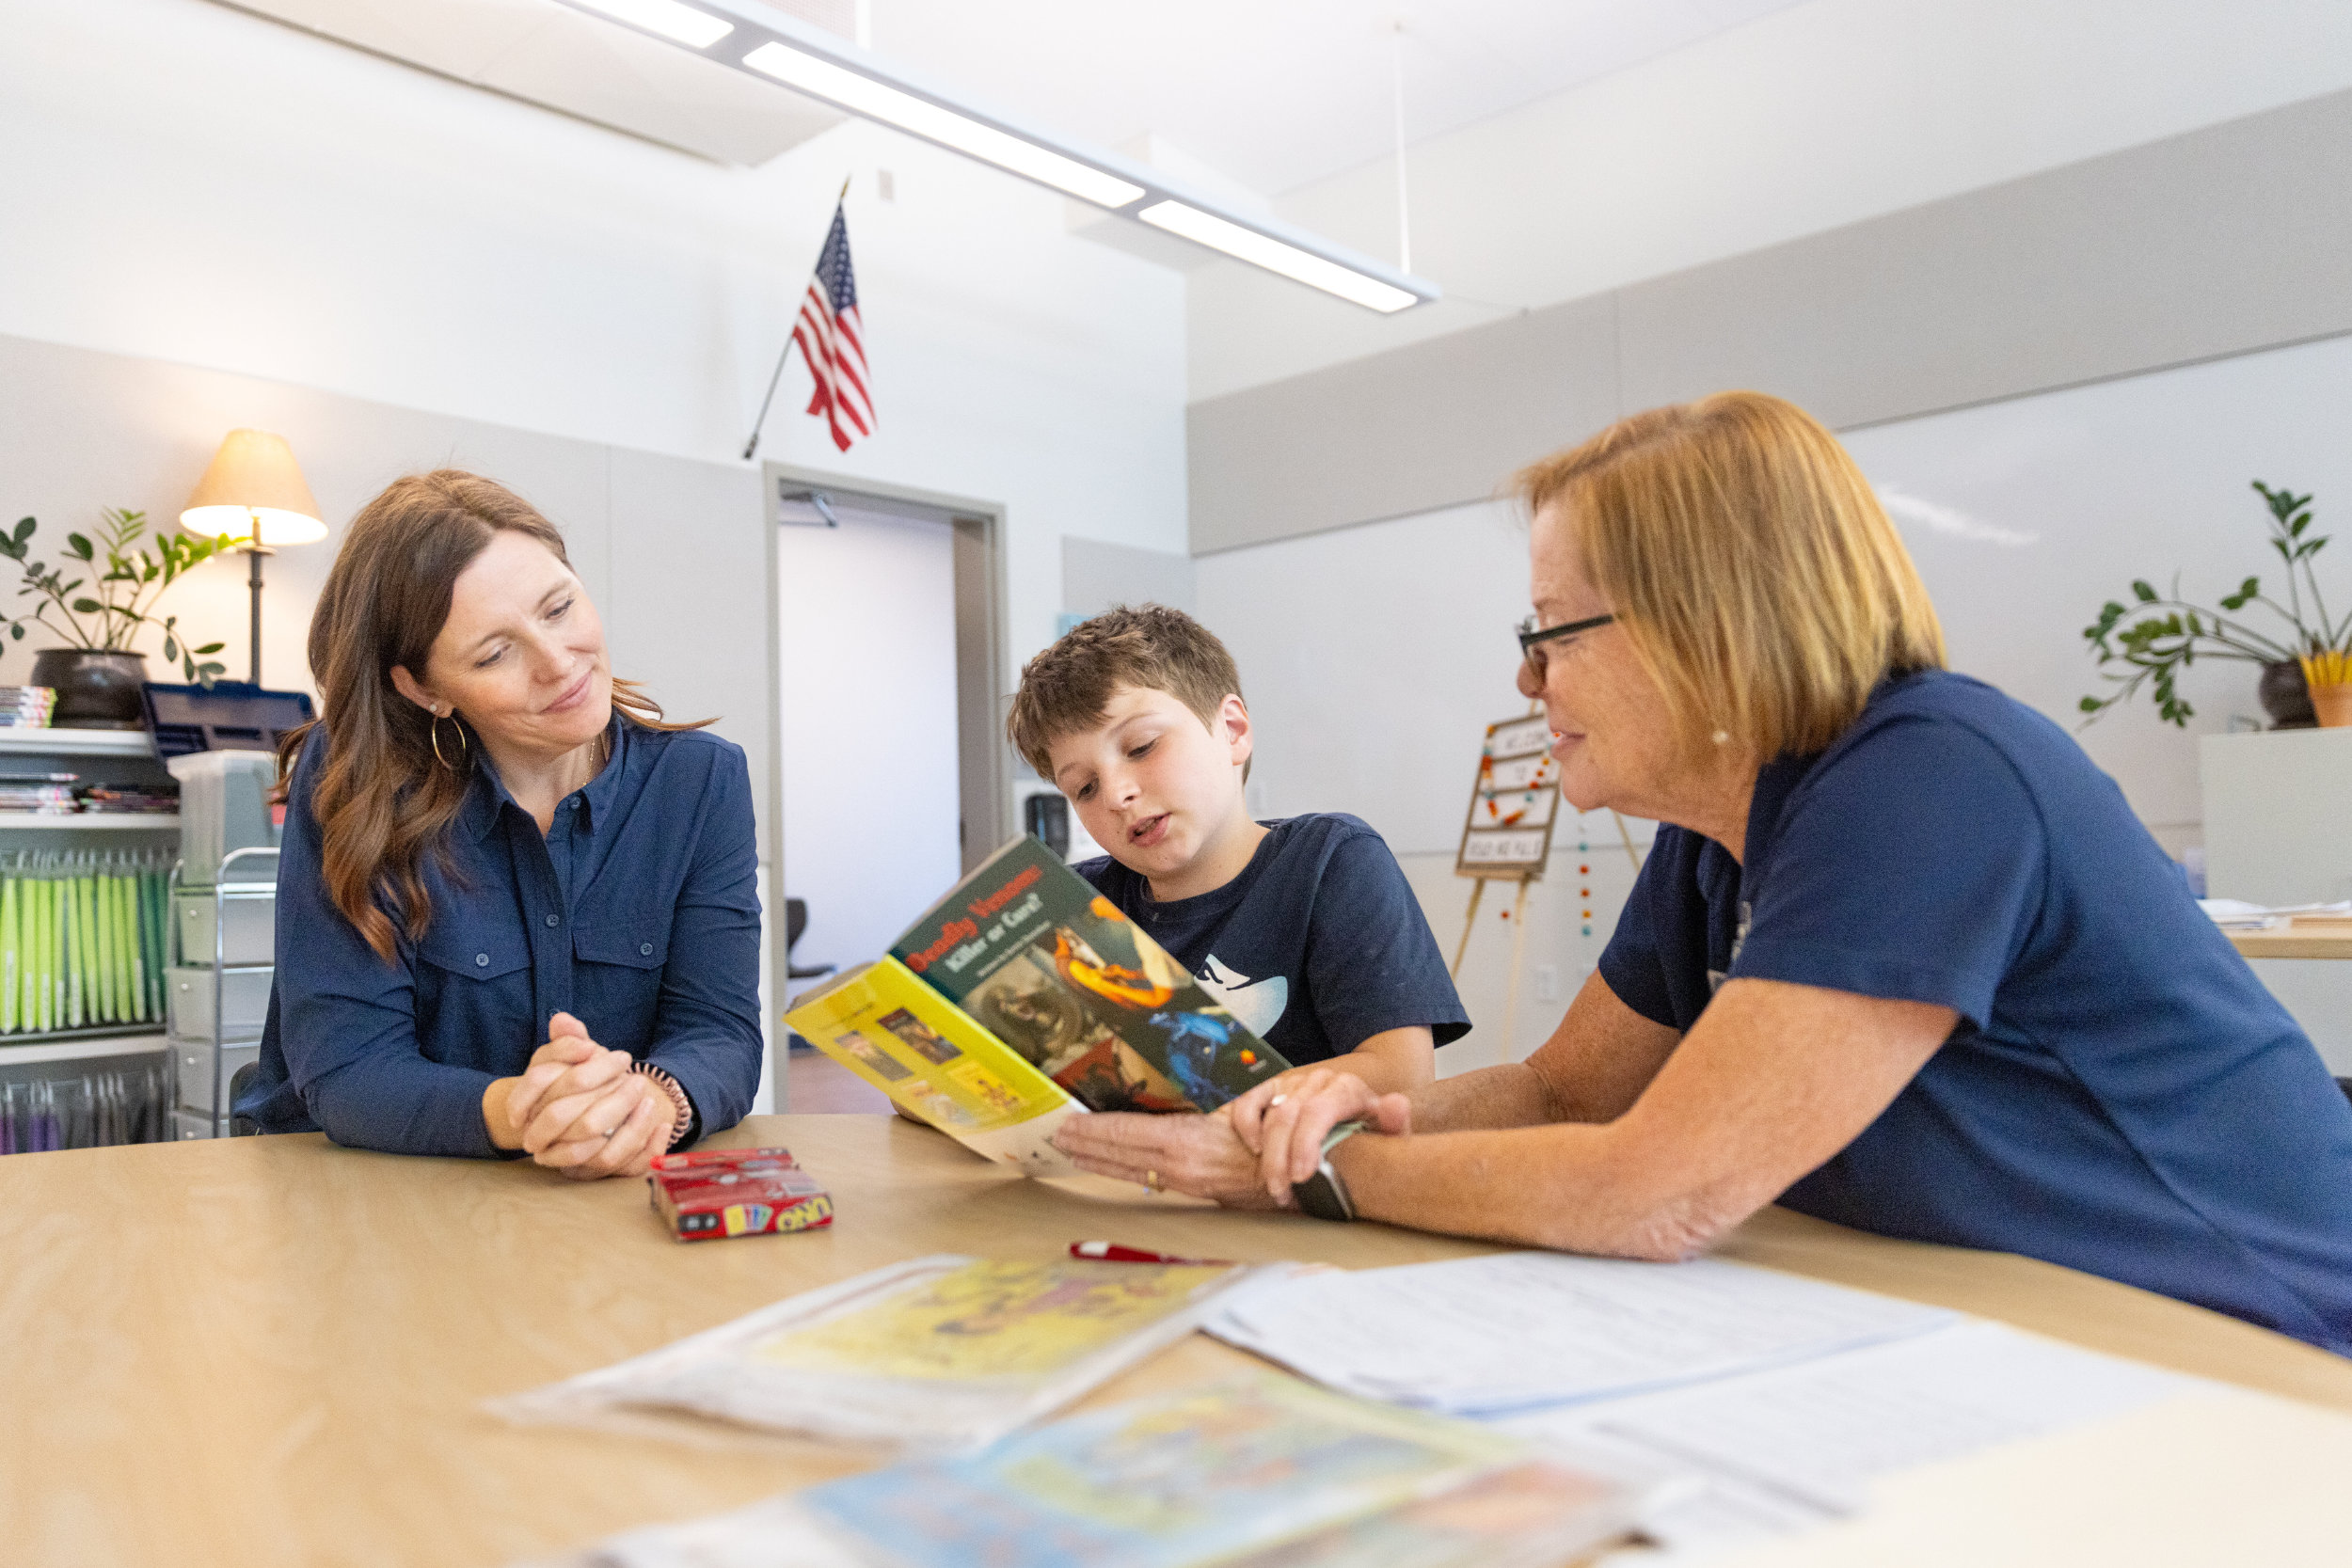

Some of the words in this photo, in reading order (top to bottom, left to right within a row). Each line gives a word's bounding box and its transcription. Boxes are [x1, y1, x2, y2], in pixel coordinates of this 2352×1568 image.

[907, 918, 977, 972] Deadly
[945, 939, 987, 972] Killer
[987, 925, 1005, 942] or
[777, 1197, 833, 1231] UNO
